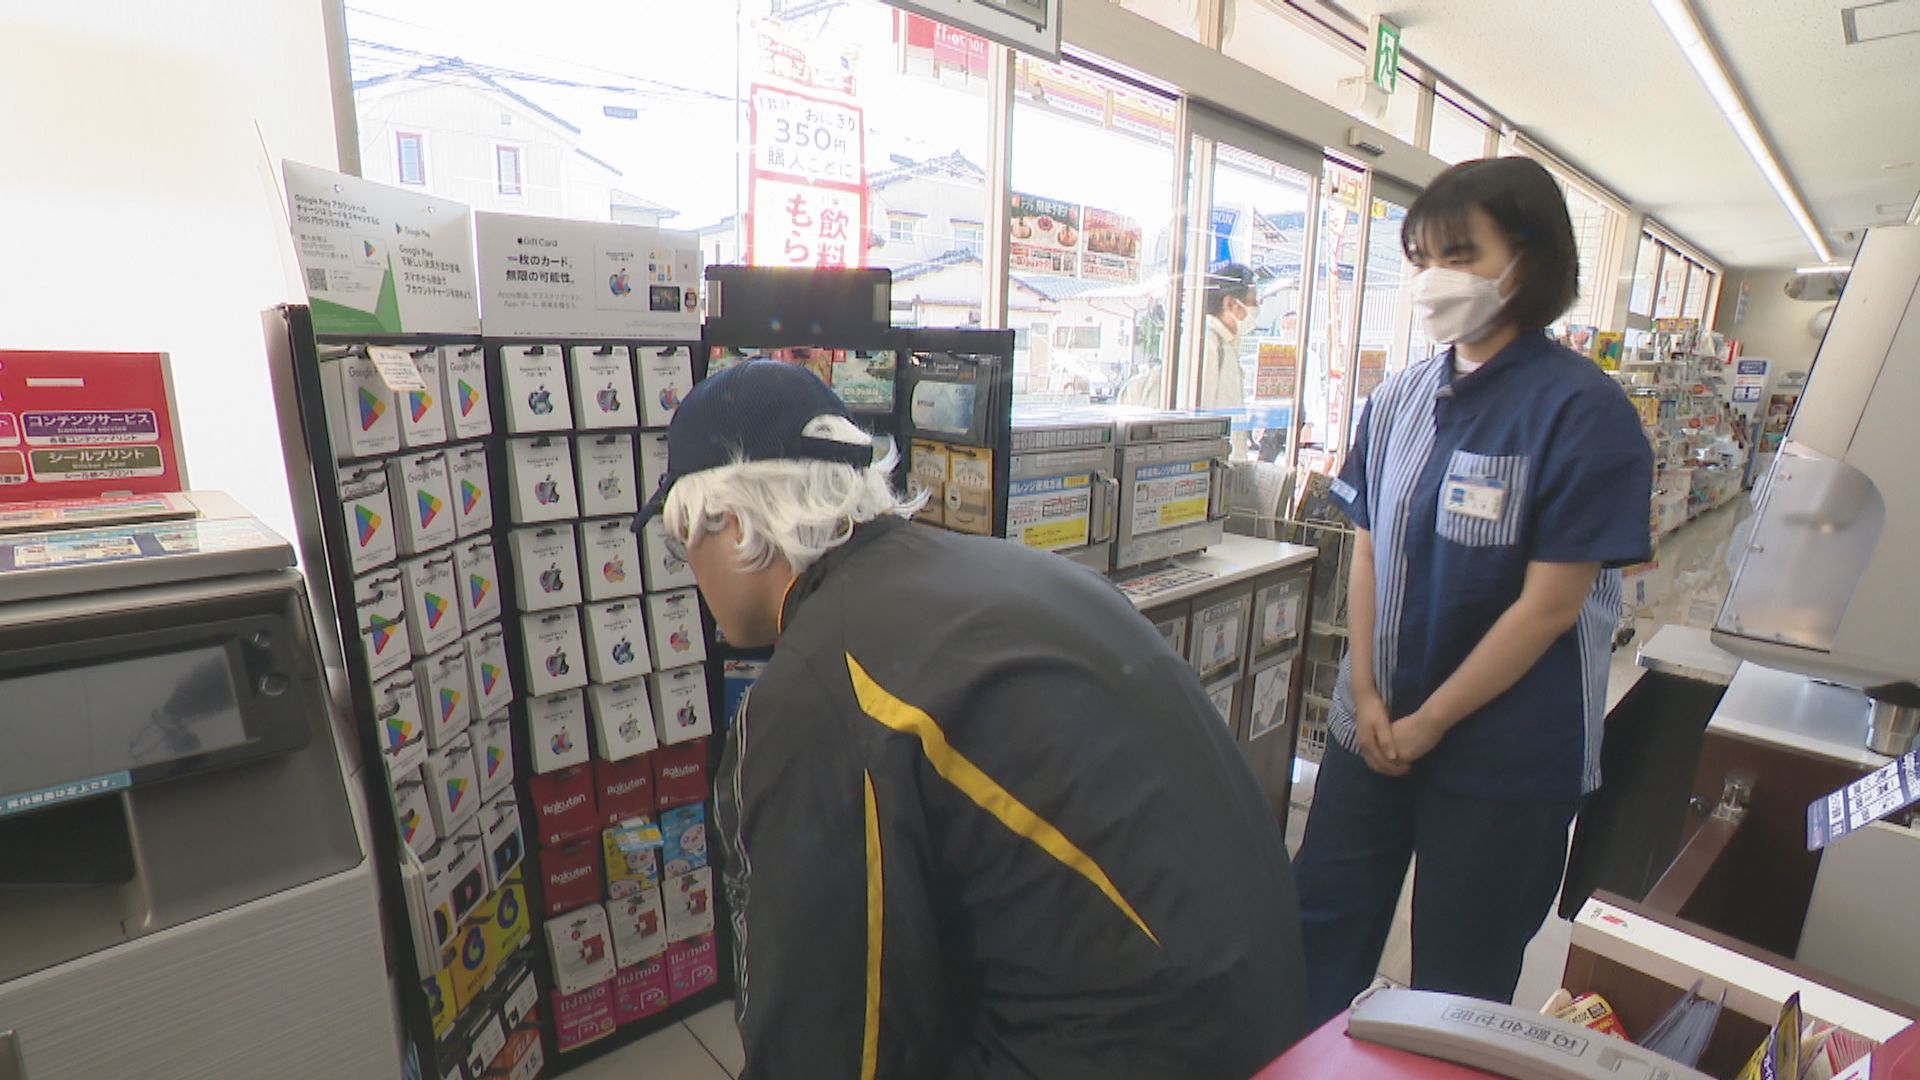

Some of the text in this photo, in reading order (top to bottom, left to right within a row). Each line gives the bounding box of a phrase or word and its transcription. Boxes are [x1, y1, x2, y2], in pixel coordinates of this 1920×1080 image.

[506, 270, 575, 285] 無限の可能性。
[27, 413, 151, 428] コンテンツサービス
[48, 449, 145, 463] シールプリント
[662, 763, 700, 778] Rakuten
[607, 776, 646, 795] Rakuten
[543, 793, 586, 815] Rakuten
[550, 864, 592, 884] Rakuten
